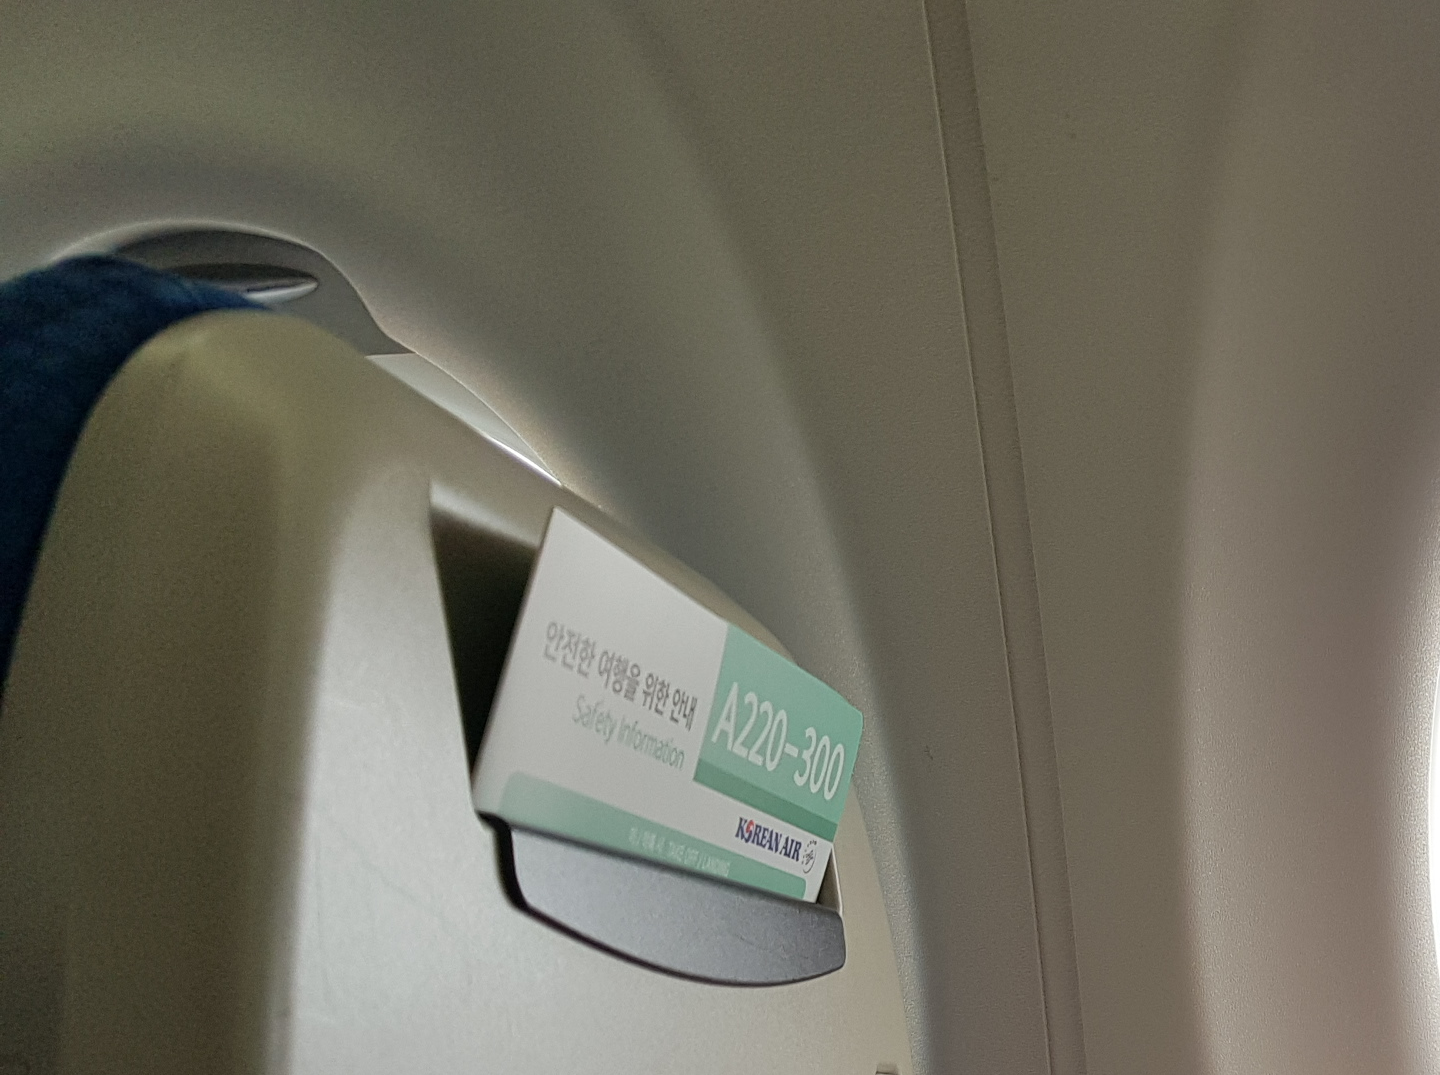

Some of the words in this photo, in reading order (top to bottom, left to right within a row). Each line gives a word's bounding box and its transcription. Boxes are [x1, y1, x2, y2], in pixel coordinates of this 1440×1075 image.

[543, 621, 596, 678] 안전한
[598, 650, 641, 702] 여행을
[642, 673, 670, 716] 위한
[669, 688, 698, 732] 안내
[572, 694, 617, 745] Safety
[617, 714, 685, 771] Information
[711, 682, 845, 801] A220-300
[735, 817, 782, 854] KOREAN
[780, 836, 802, 861] AIR
